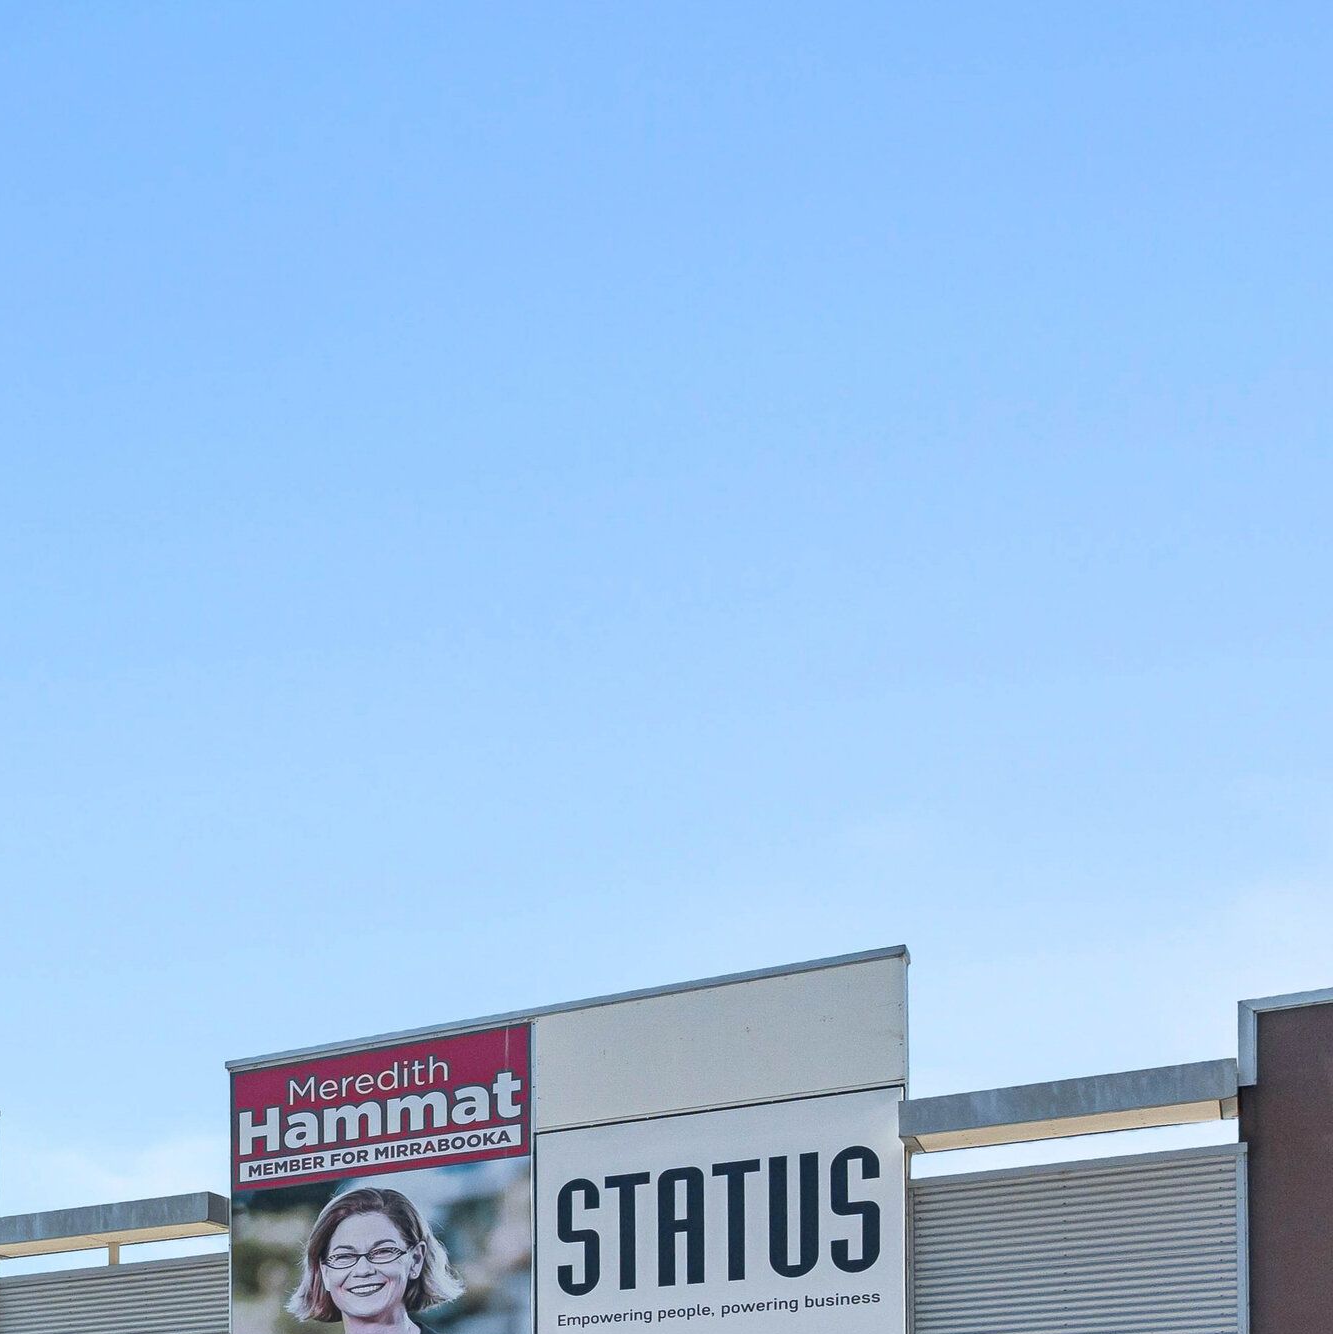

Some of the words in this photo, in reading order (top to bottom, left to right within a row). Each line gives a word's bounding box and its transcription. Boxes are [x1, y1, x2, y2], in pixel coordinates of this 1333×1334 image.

[289, 1055, 450, 1106] Meredith
[238, 1072, 523, 1156] Hammat
[247, 1155, 325, 1178] MEMBER
[330, 1148, 369, 1168] FOR
[374, 1129, 512, 1160] MIRRABOOKA
[556, 1144, 881, 1297] STATUS
[556, 1307, 653, 1328] Empowering
[657, 1302, 715, 1322] people,
[720, 1296, 799, 1317] powering
[804, 1291, 881, 1310] business
